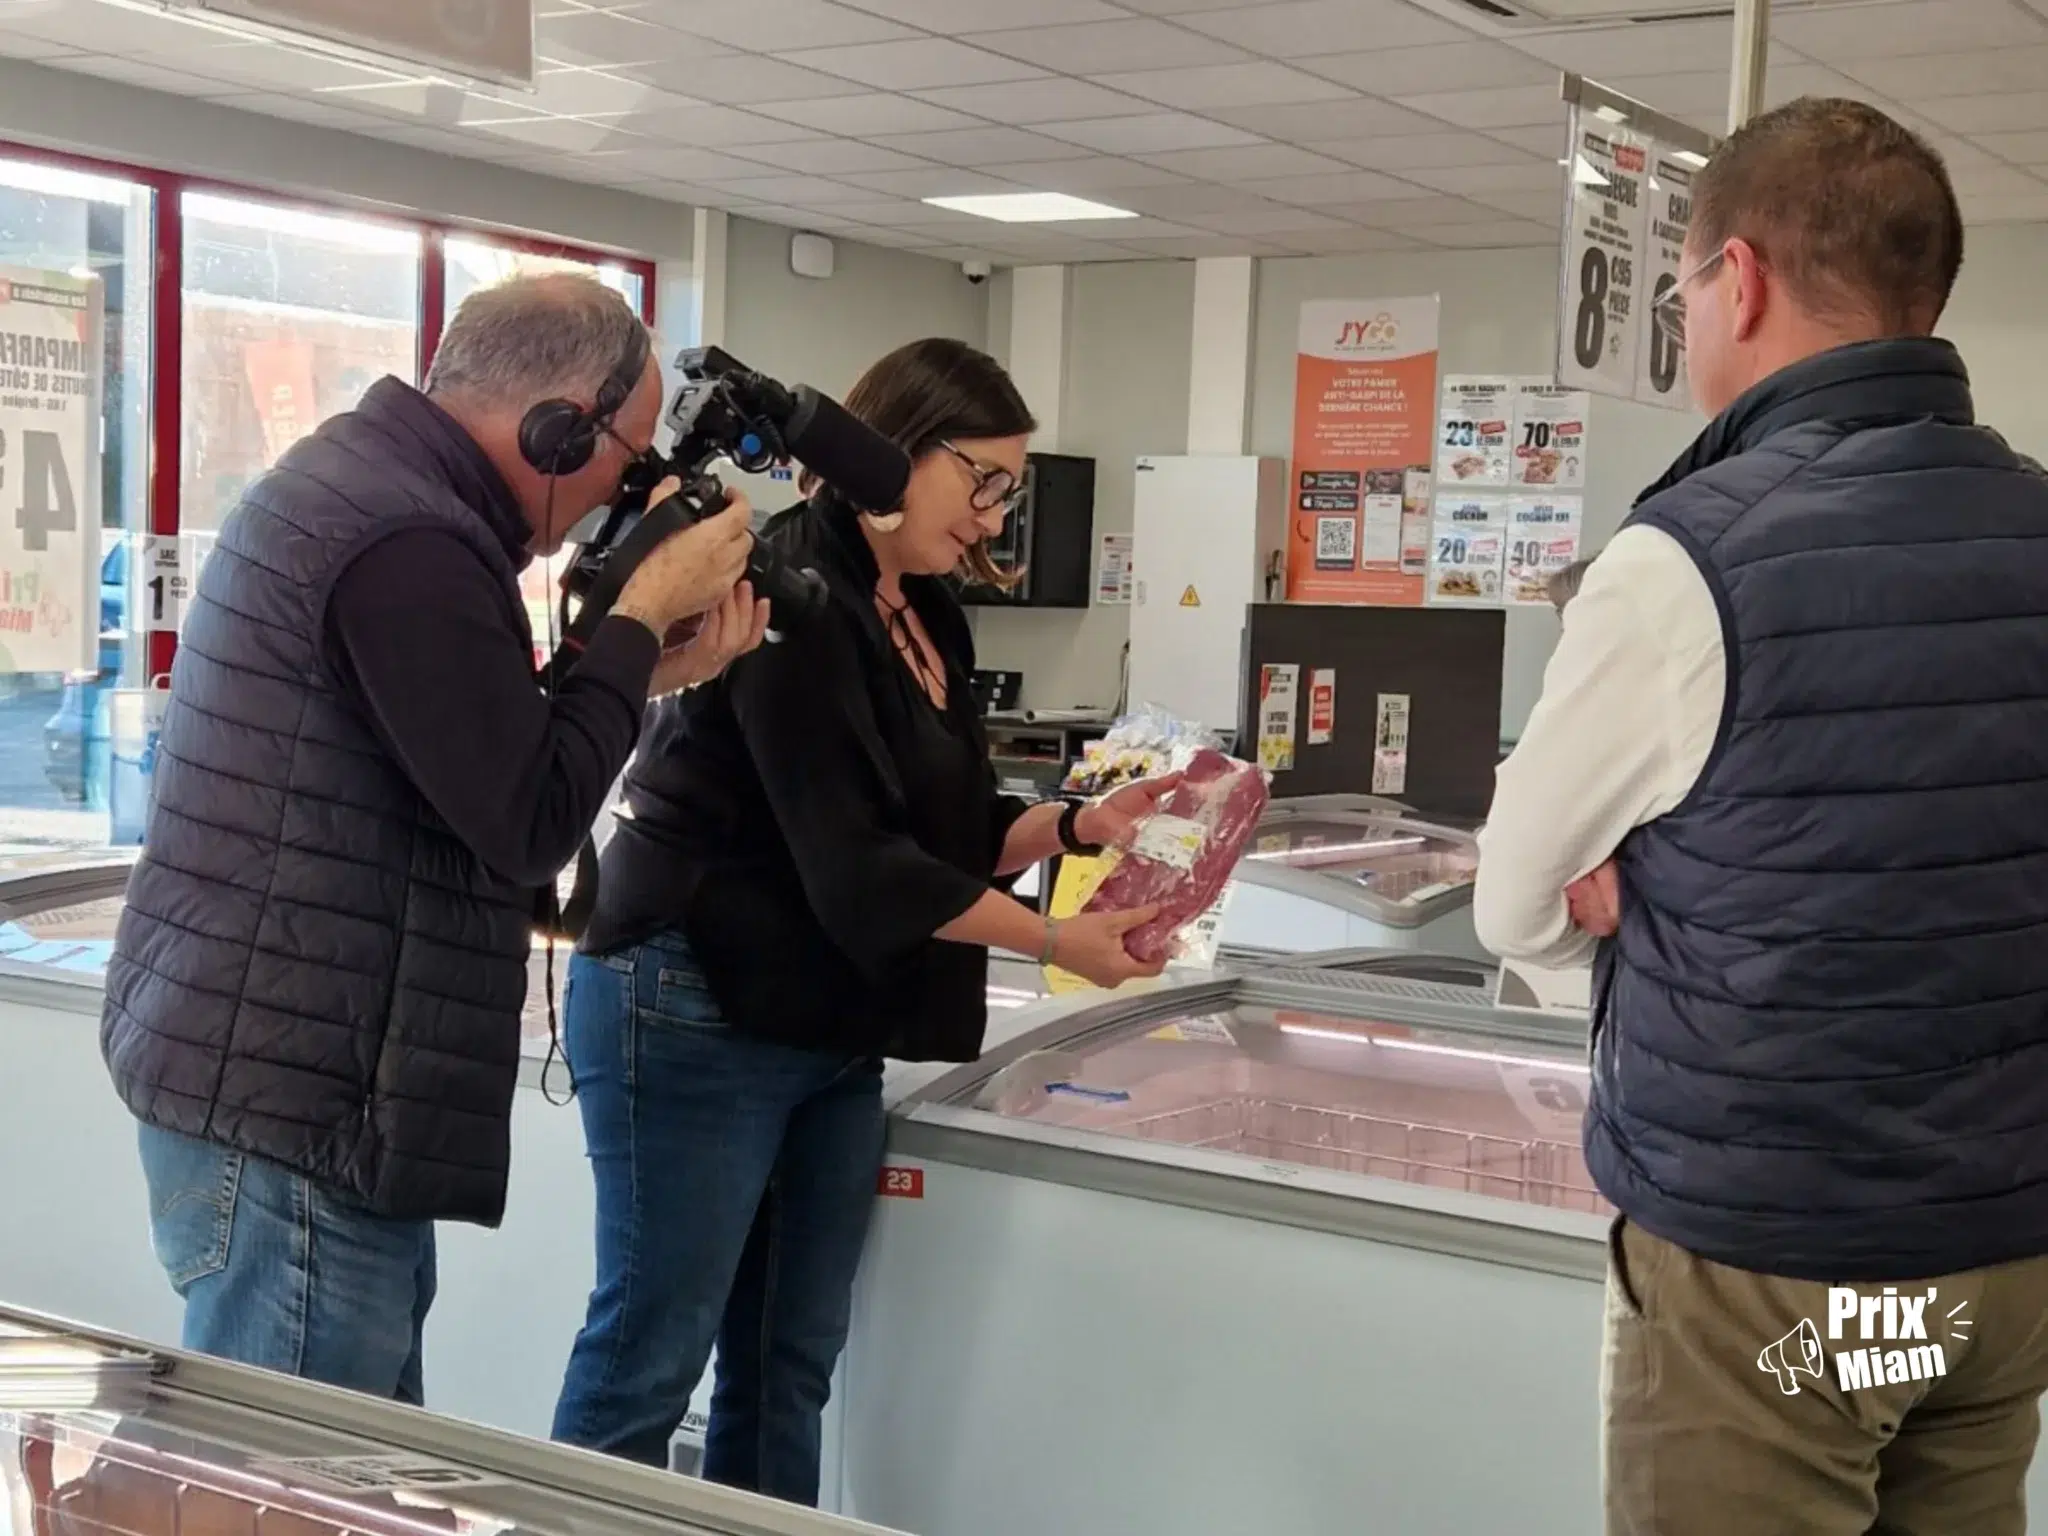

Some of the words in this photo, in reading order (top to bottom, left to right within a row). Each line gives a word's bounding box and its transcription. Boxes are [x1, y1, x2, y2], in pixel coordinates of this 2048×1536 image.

[1575, 246, 1608, 369] 8
[148, 575, 163, 620] 1
[887, 1170, 913, 1191] 23
